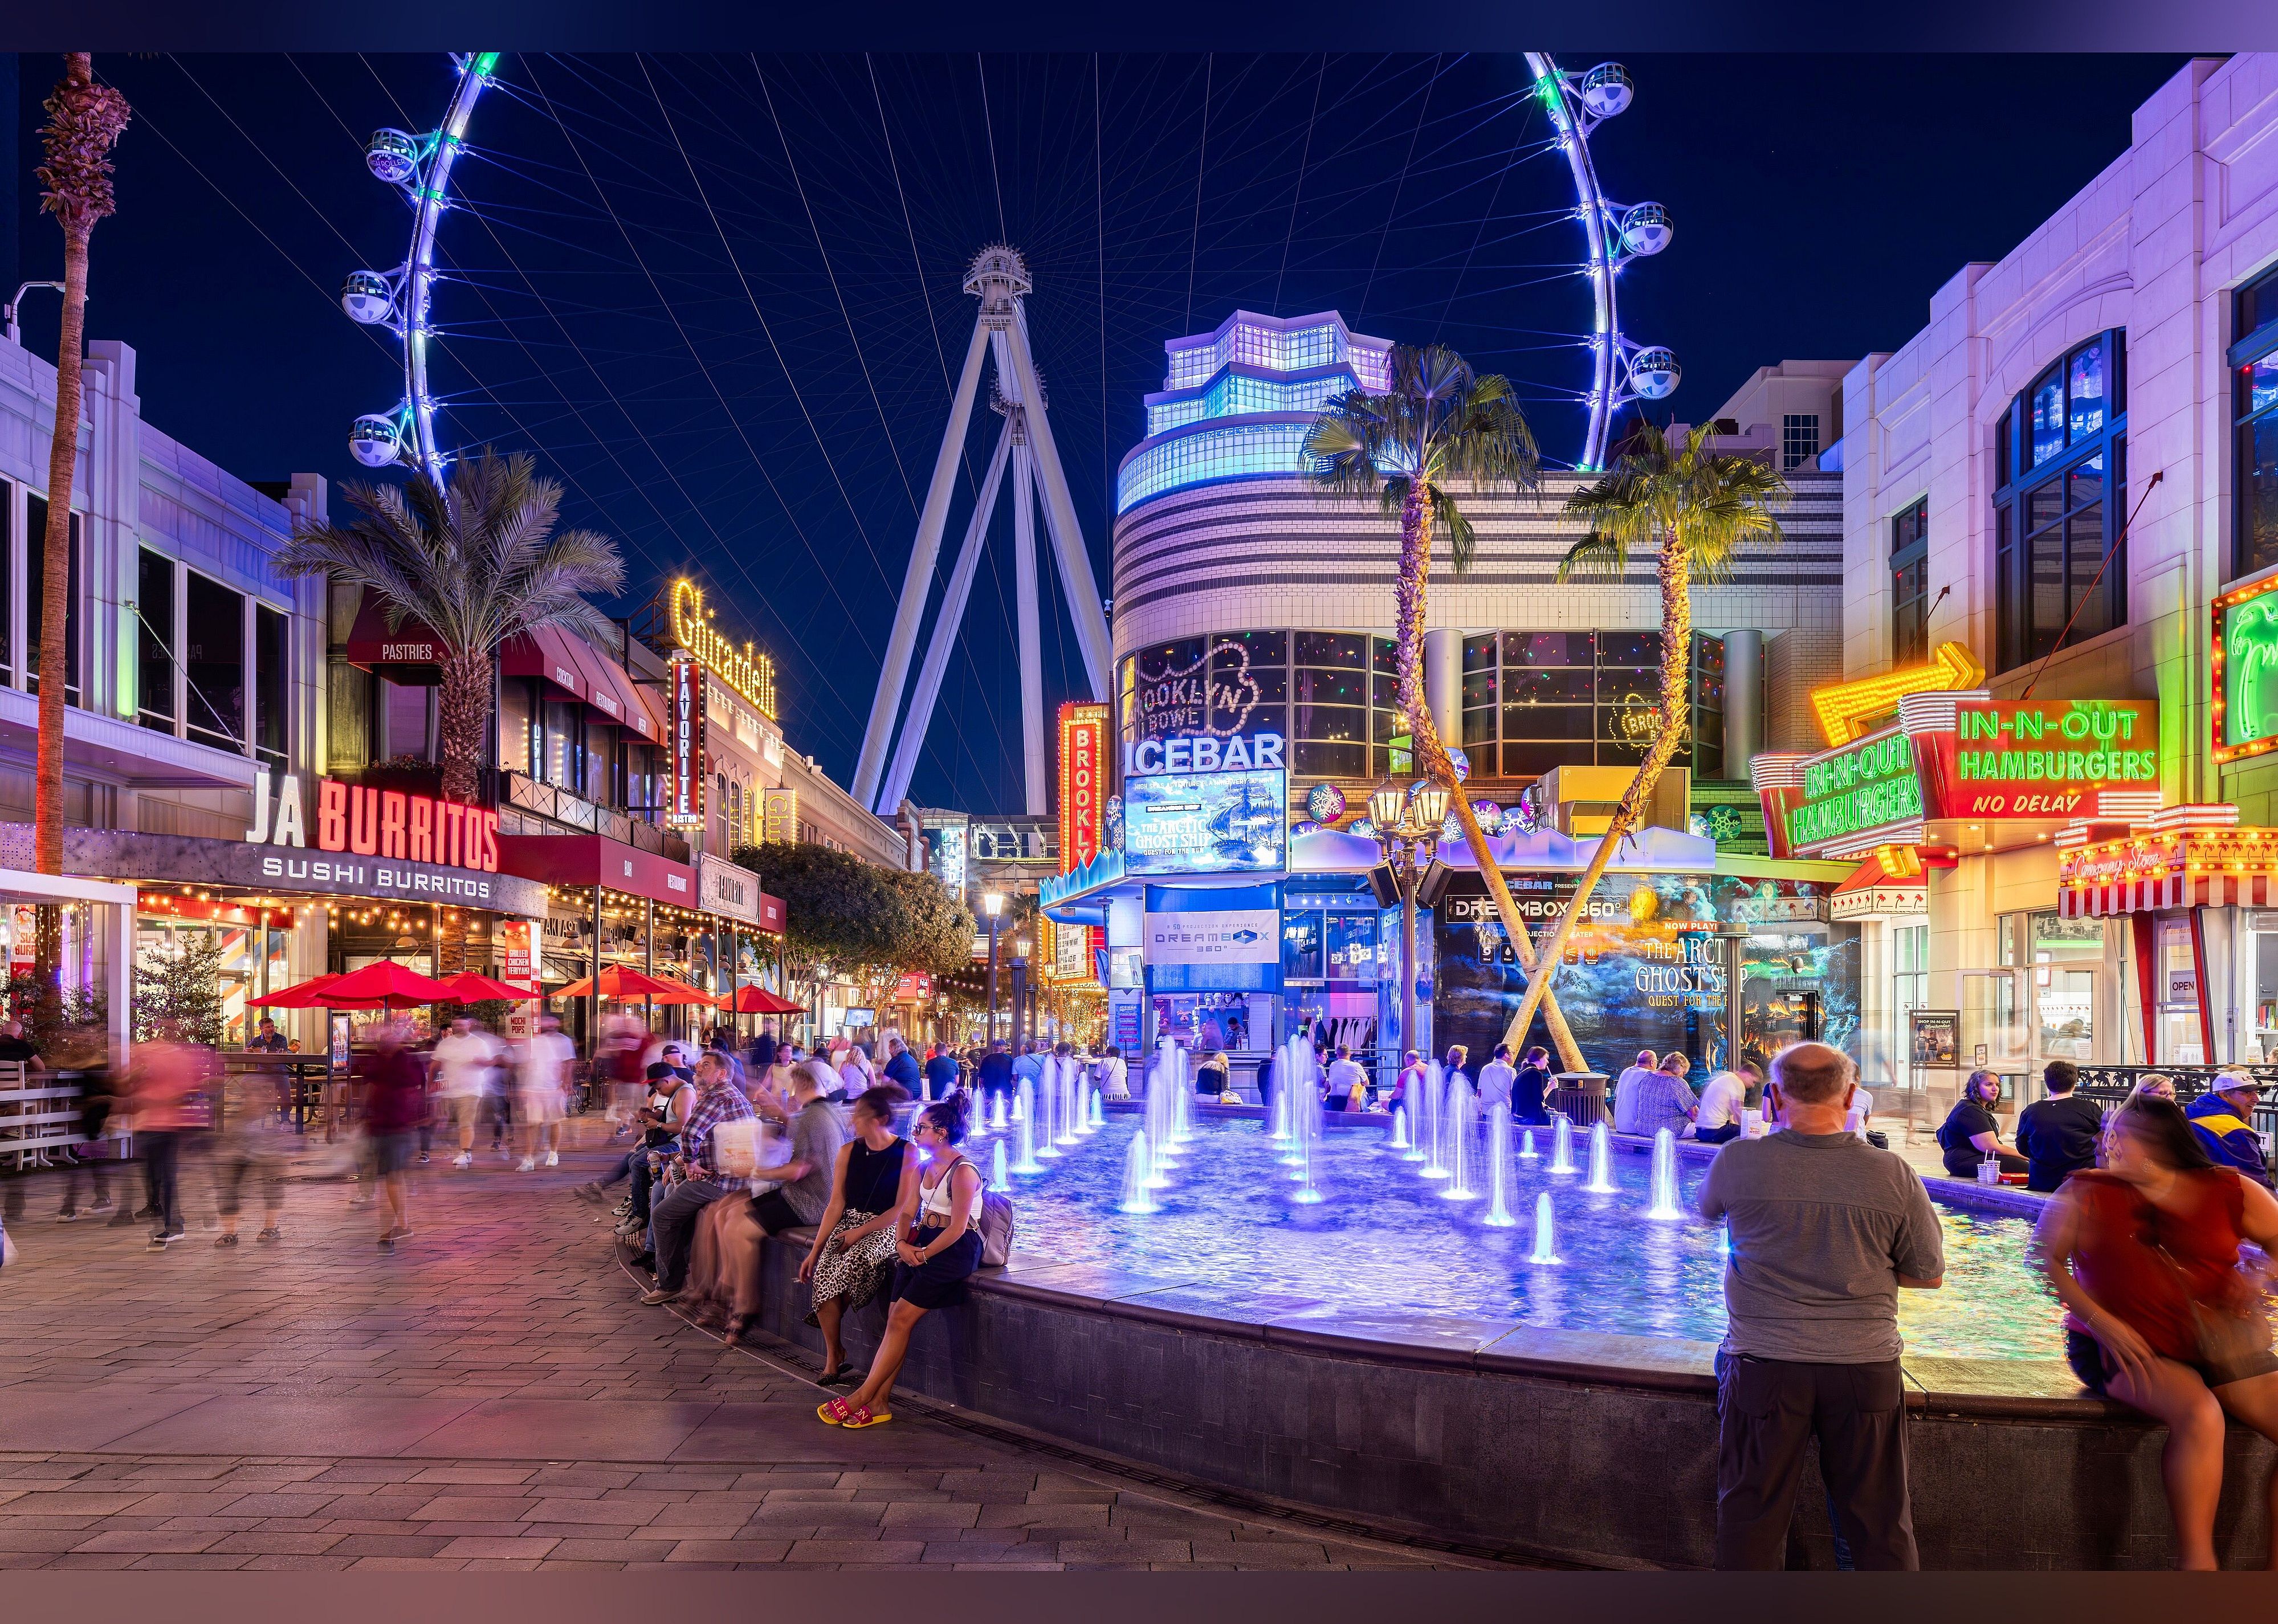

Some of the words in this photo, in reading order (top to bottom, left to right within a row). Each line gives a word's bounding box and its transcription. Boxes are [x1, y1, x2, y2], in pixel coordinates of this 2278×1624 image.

[381, 158, 406, 169] ROLLER
[382, 644, 432, 660] PASTRIES
[674, 580, 776, 720] Ghirardelli
[556, 666, 574, 691] COCKTAIL
[596, 691, 617, 716] RESTAURANT
[638, 717, 647, 733] BEER
[1961, 711, 2139, 740] IN-N-OUT
[678, 664, 690, 814] FAVORITE
[1125, 733, 1285, 776] ICEBAR
[1805, 733, 1910, 798] IN-N-OUT
[1961, 751, 2156, 780] HAMBURGERS
[1076, 729, 1090, 862] BROOKLY
[1973, 795, 2005, 813] NO
[2013, 795, 2081, 813] DELAY
[1794, 772, 1922, 844] HAMBURGERS
[673, 814, 697, 823] BISTRO
[769, 795, 788, 844] Ghir
[1158, 818, 1208, 834] ARCTIC
[1135, 834, 1179, 849] GHOST
[1180, 834, 1212, 848] SHIP
[2075, 855, 2125, 881] Company
[262, 858, 364, 884] SUSHI
[377, 868, 489, 899] BURRITOS
[667, 873, 687, 893] RESTAURANT
[1507, 880, 1553, 889] CEBAR
[1456, 901, 1571, 916] DREMBOX
[20, 932, 36, 944] SUS
[2163, 924, 2191, 935] Merchan
[15, 945, 36, 956] BURR
[1644, 942, 1672, 959] THE
[1673, 937, 1727, 964] ARCT
[507, 966, 530, 975] TERIYAKI
[508, 958, 529, 966] CHICKEN
[1636, 966, 1706, 993] GHOST
[1711, 967, 1748, 993] SP
[2173, 982, 2194, 991] OPEN
[1649, 995, 1679, 1006] QUEST
[1684, 995, 1701, 1006] FOR
[1706, 995, 1721, 1006] THE
[855, 1408, 868, 1420] ON
